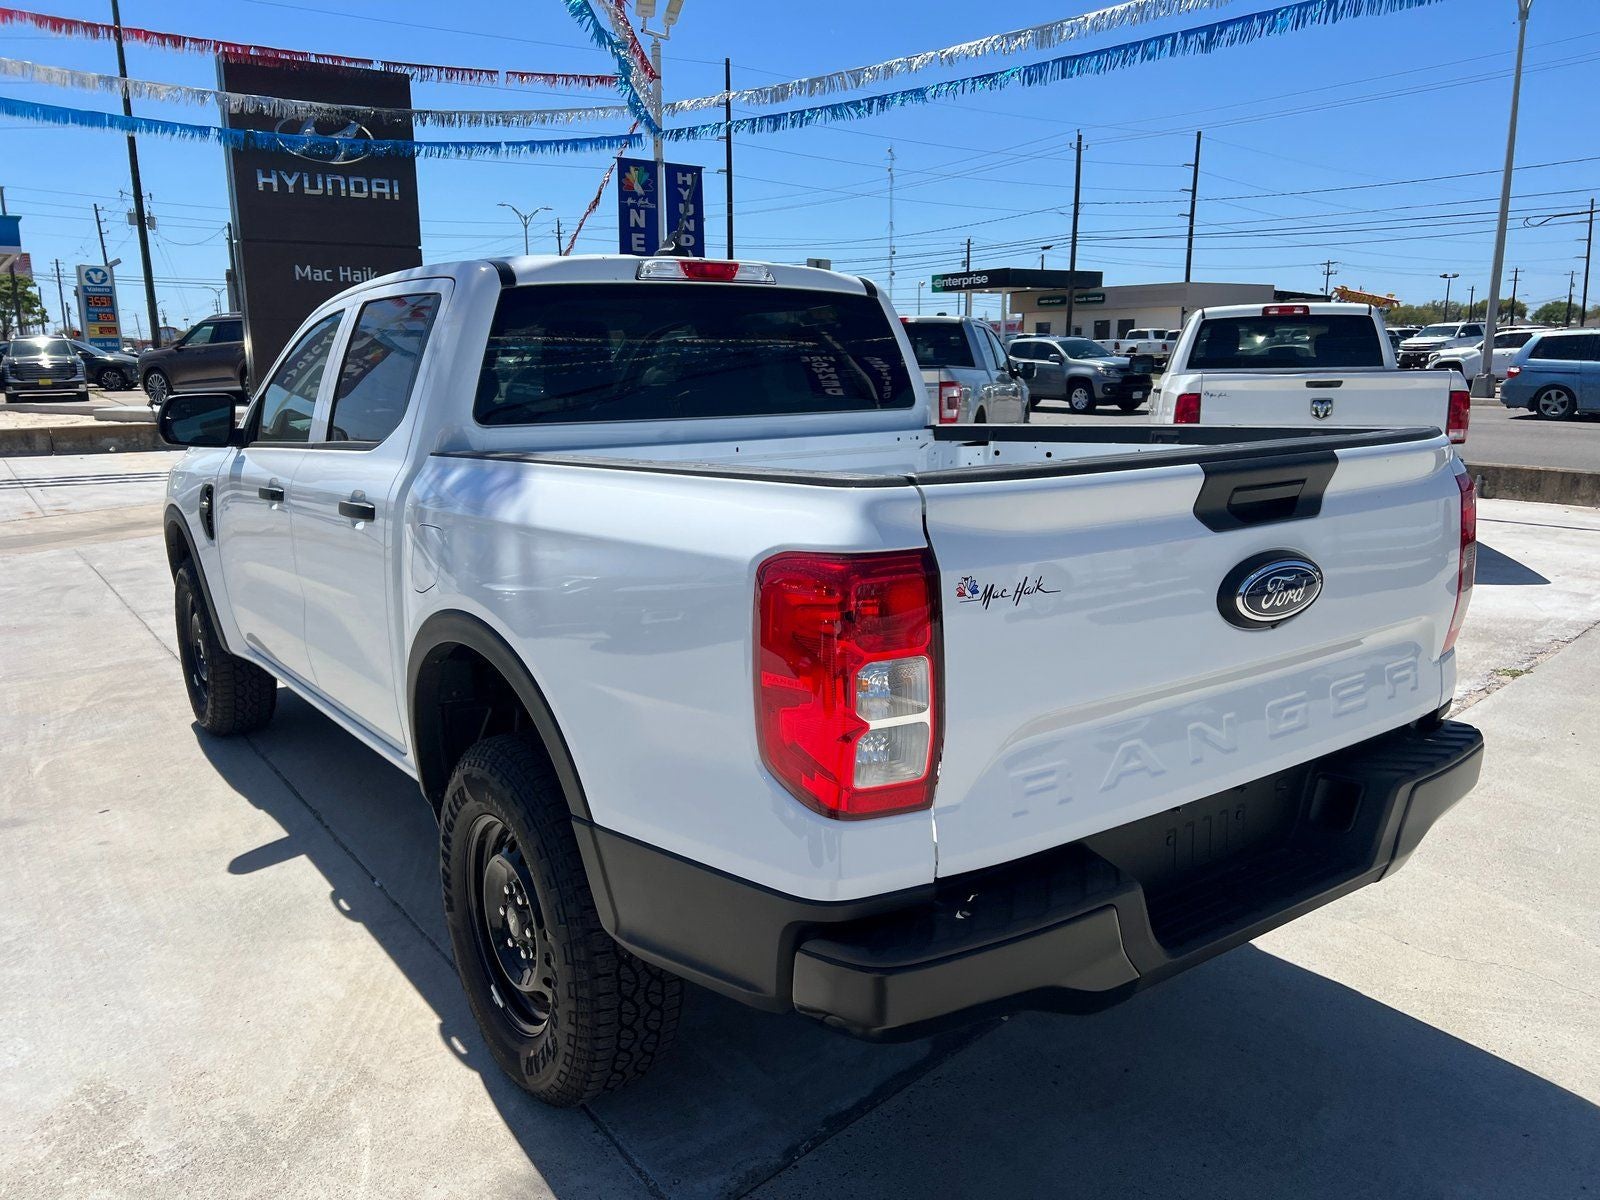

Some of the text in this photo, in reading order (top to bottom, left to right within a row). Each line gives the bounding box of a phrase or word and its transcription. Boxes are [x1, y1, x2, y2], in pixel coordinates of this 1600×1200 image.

[256, 168, 400, 200] HYUNDAI
[676, 172, 695, 257] HYUND
[294, 264, 377, 283] Mac Haik
[933, 274, 989, 288] enterprise
[972, 576, 1061, 610] Mac Haik
[1261, 574, 1307, 610] Ford
[1008, 653, 1420, 818] RANGER
